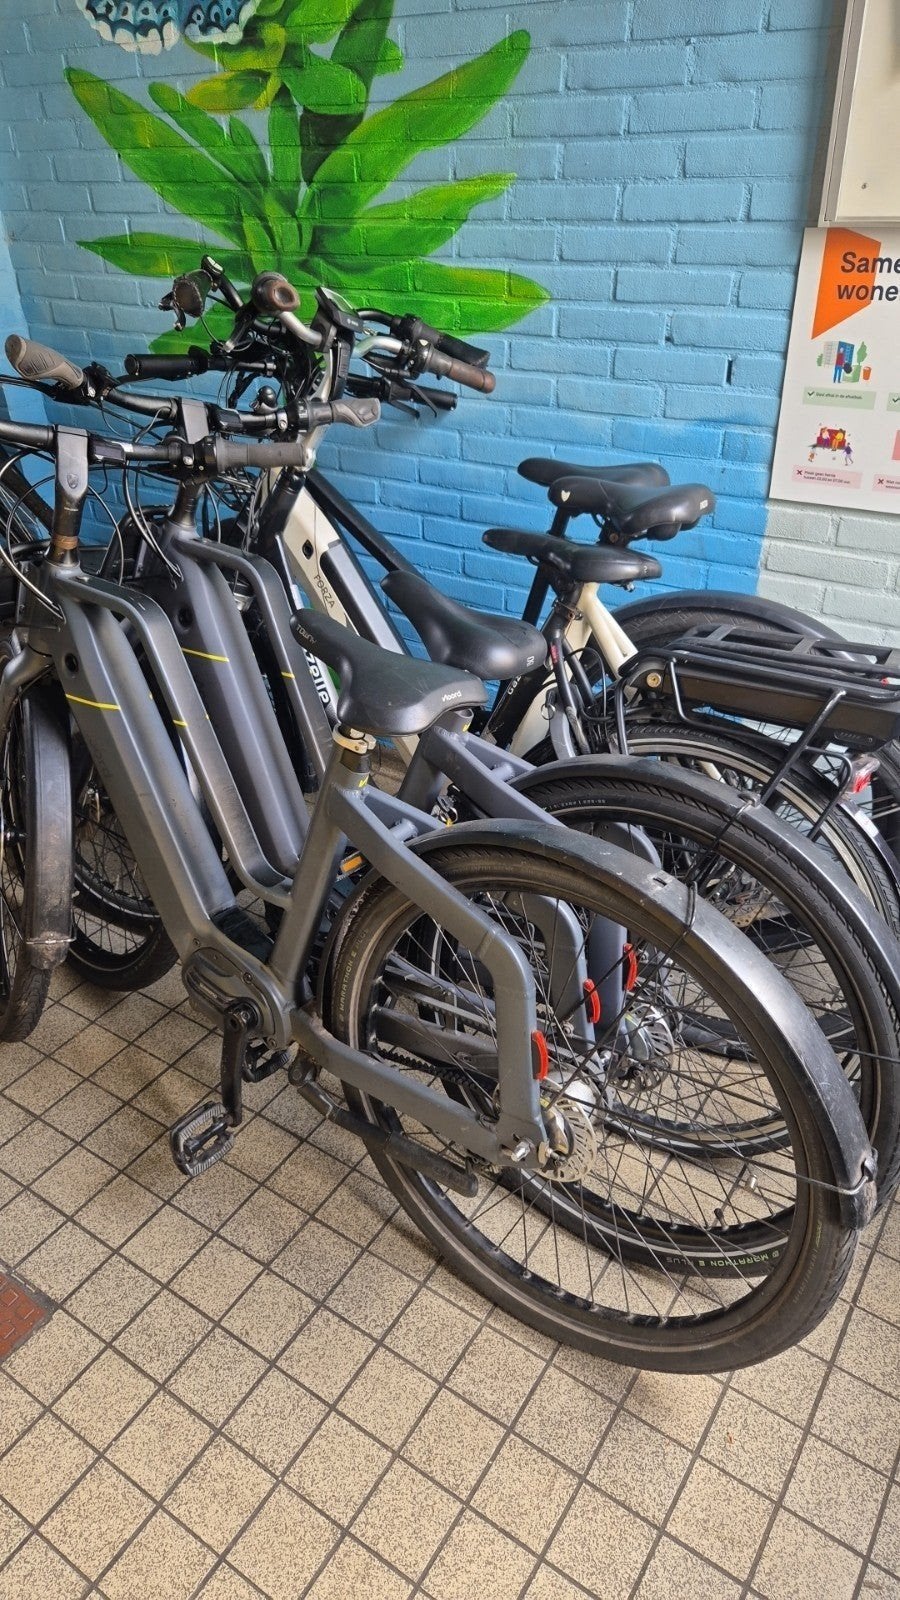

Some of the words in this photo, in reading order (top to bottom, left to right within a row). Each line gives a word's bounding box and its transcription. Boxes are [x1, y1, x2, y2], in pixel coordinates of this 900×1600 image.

[313, 574, 335, 609] FORZA
[339, 960, 354, 1011] MARATHON
[710, 1252, 769, 1267] MARATHON
